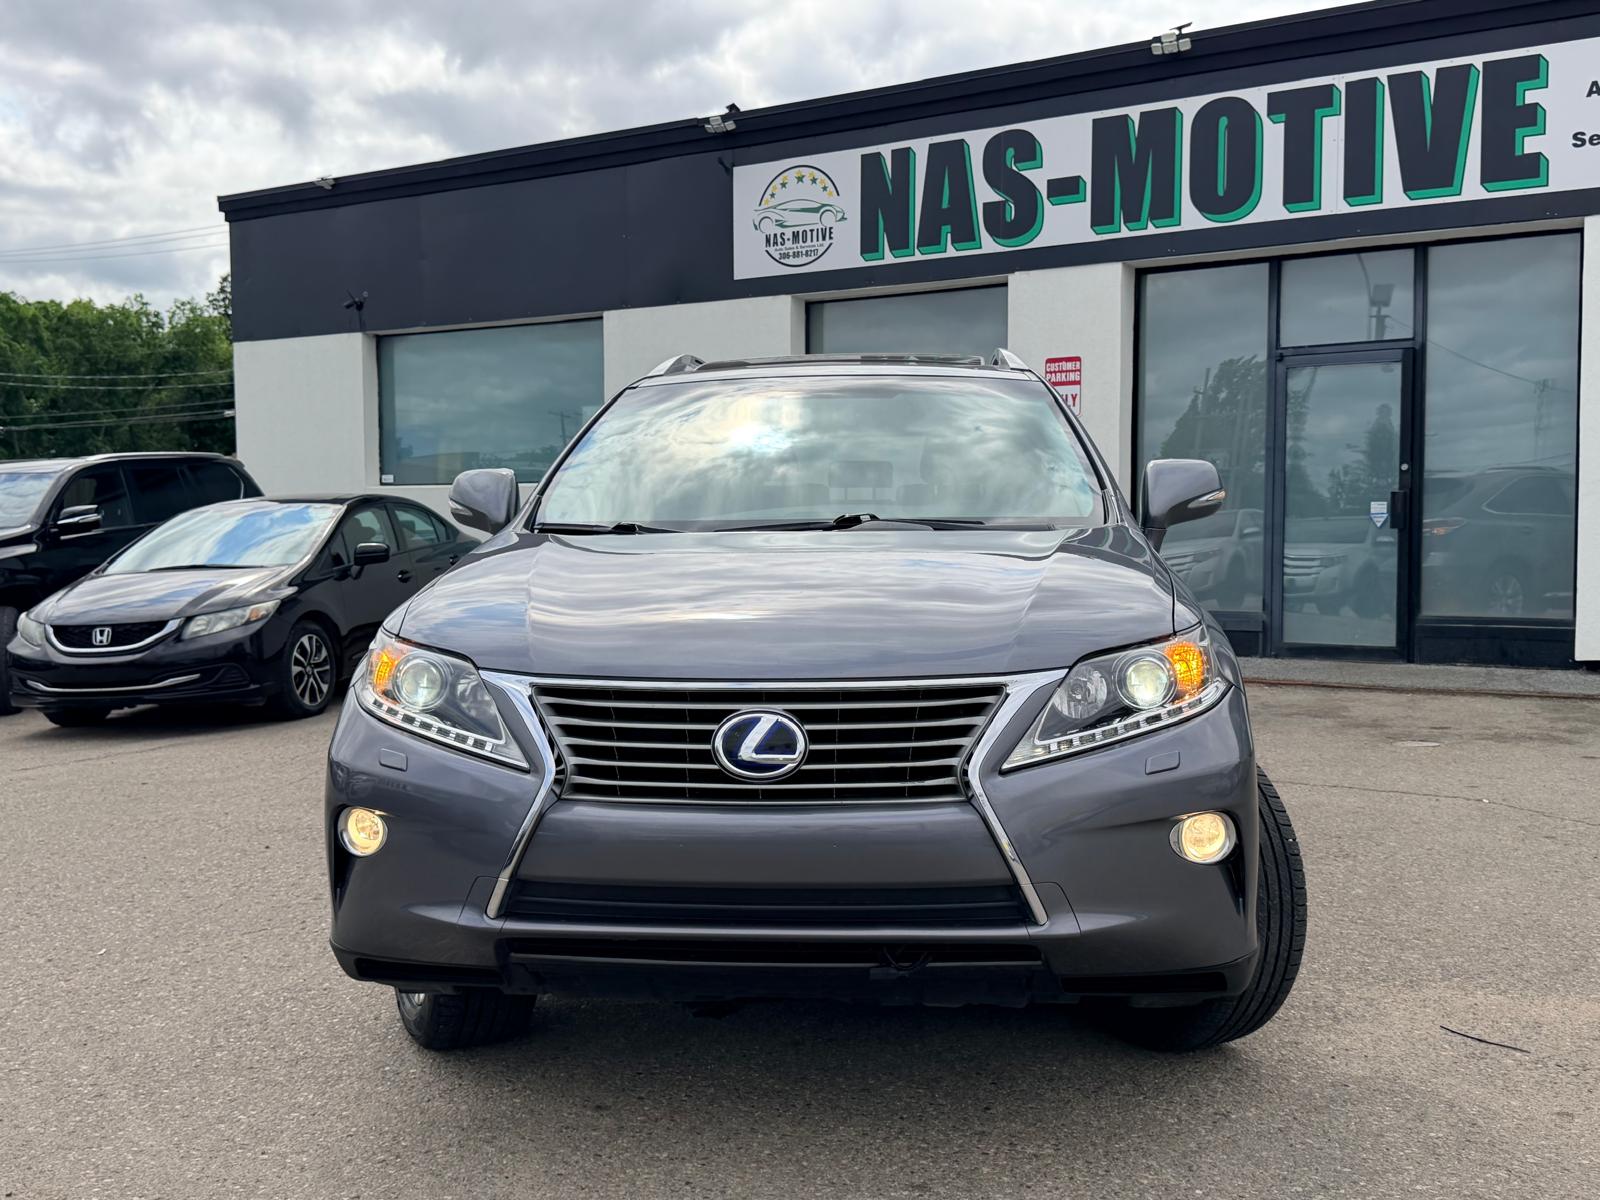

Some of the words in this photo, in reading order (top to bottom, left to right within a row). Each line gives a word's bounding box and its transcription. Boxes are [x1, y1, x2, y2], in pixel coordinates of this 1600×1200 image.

[860, 54, 1550, 263] NAS-MOTIVE
[765, 226, 834, 248] NAS-MOTIVE
[1046, 361, 1081, 372] CUSTOMER
[1046, 371, 1081, 383] PARKING
